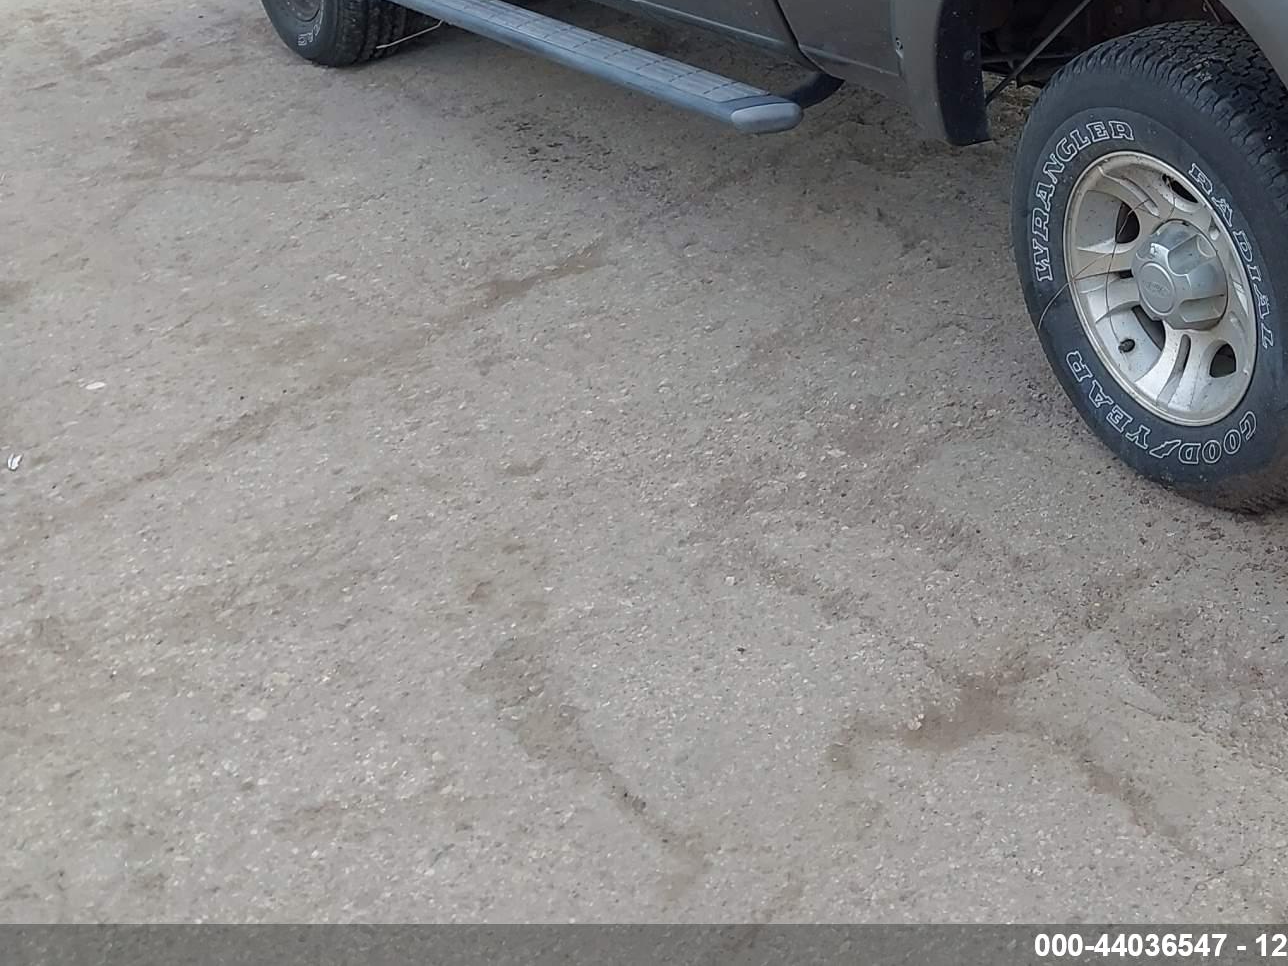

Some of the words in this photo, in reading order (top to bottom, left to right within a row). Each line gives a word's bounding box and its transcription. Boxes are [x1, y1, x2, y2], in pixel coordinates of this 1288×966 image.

[1032, 120, 1135, 283] WRANGLER
[1188, 162, 1274, 349] RADIAL
[1066, 350, 1257, 465] GOODYEAR
